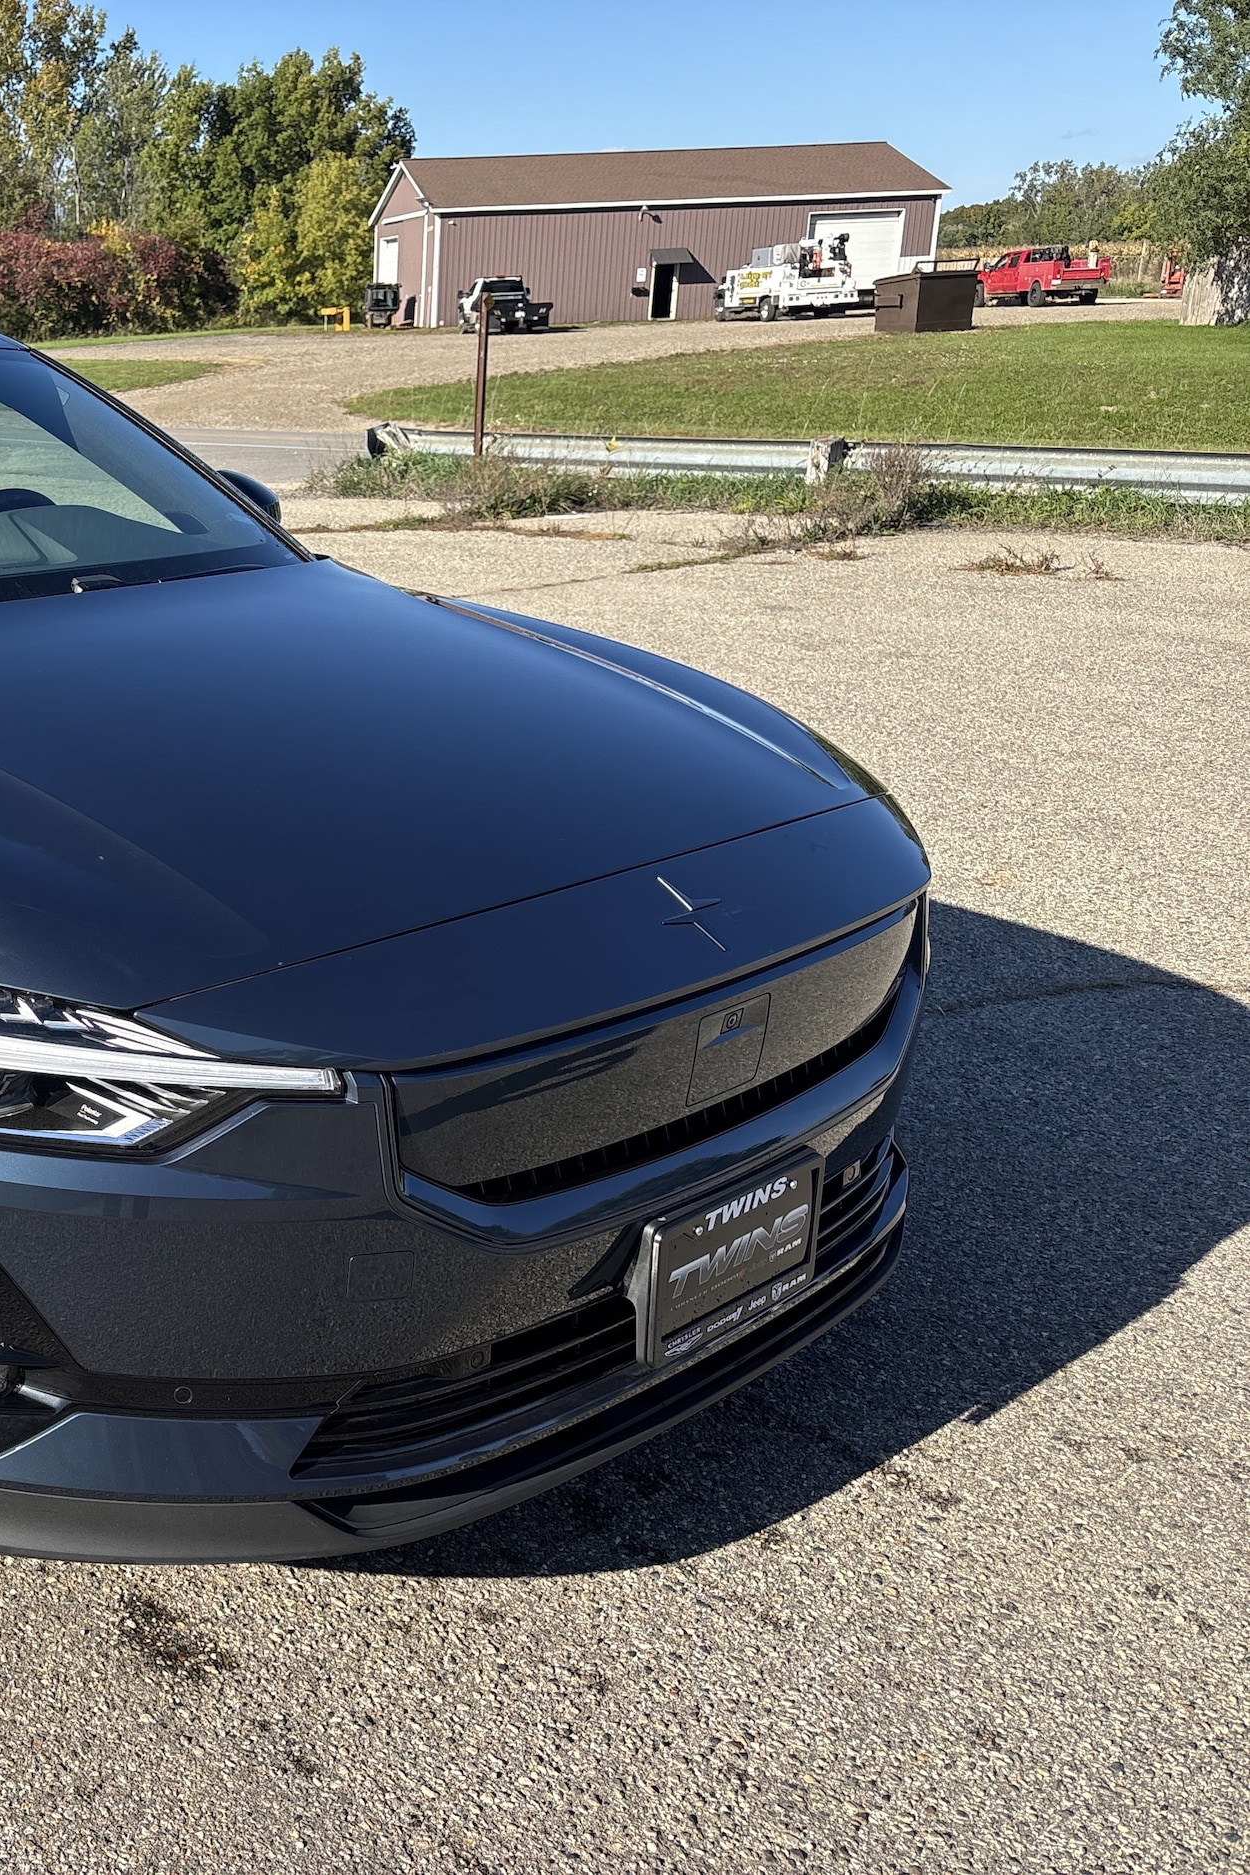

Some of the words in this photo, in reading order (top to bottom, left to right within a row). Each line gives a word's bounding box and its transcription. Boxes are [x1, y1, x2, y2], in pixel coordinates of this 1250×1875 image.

[705, 1176, 789, 1232] TWINS
[668, 1204, 809, 1299] TWINS
[776, 1238, 802, 1257] RAM
[667, 1327, 701, 1349] CHRYSLER
[748, 1295, 767, 1311] Jeep
[782, 1273, 807, 1292] RAM
